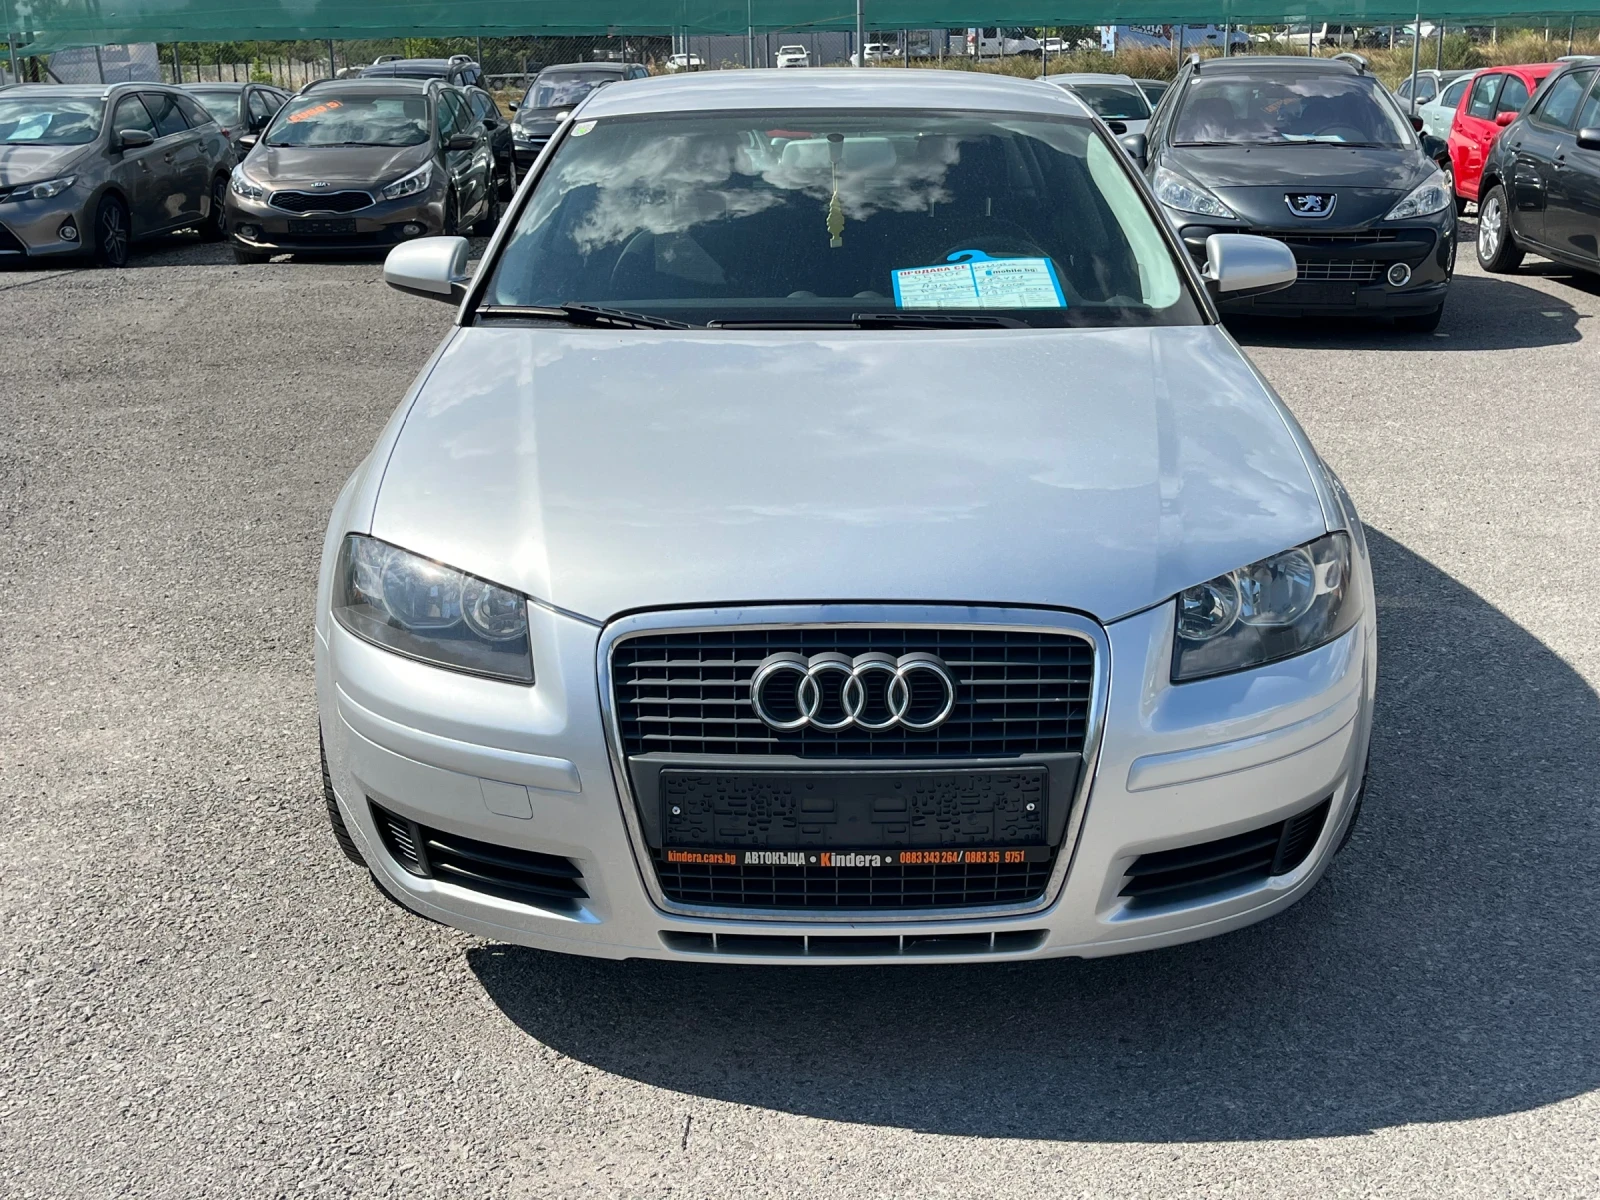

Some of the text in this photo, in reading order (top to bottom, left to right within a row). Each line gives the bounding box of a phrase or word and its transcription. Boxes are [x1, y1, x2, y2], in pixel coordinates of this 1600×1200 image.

[900, 267, 951, 276] ПРОДАВА
[668, 851, 736, 865] kindera.cars.bg
[744, 852, 806, 866] АВТОКЪЩА
[820, 853, 881, 867] Kindera
[900, 852, 922, 864] 0883
[923, 852, 940, 863] 343
[964, 851, 987, 863] 0883
[988, 851, 1000, 863] 35
[1004, 850, 1025, 863] 9751
